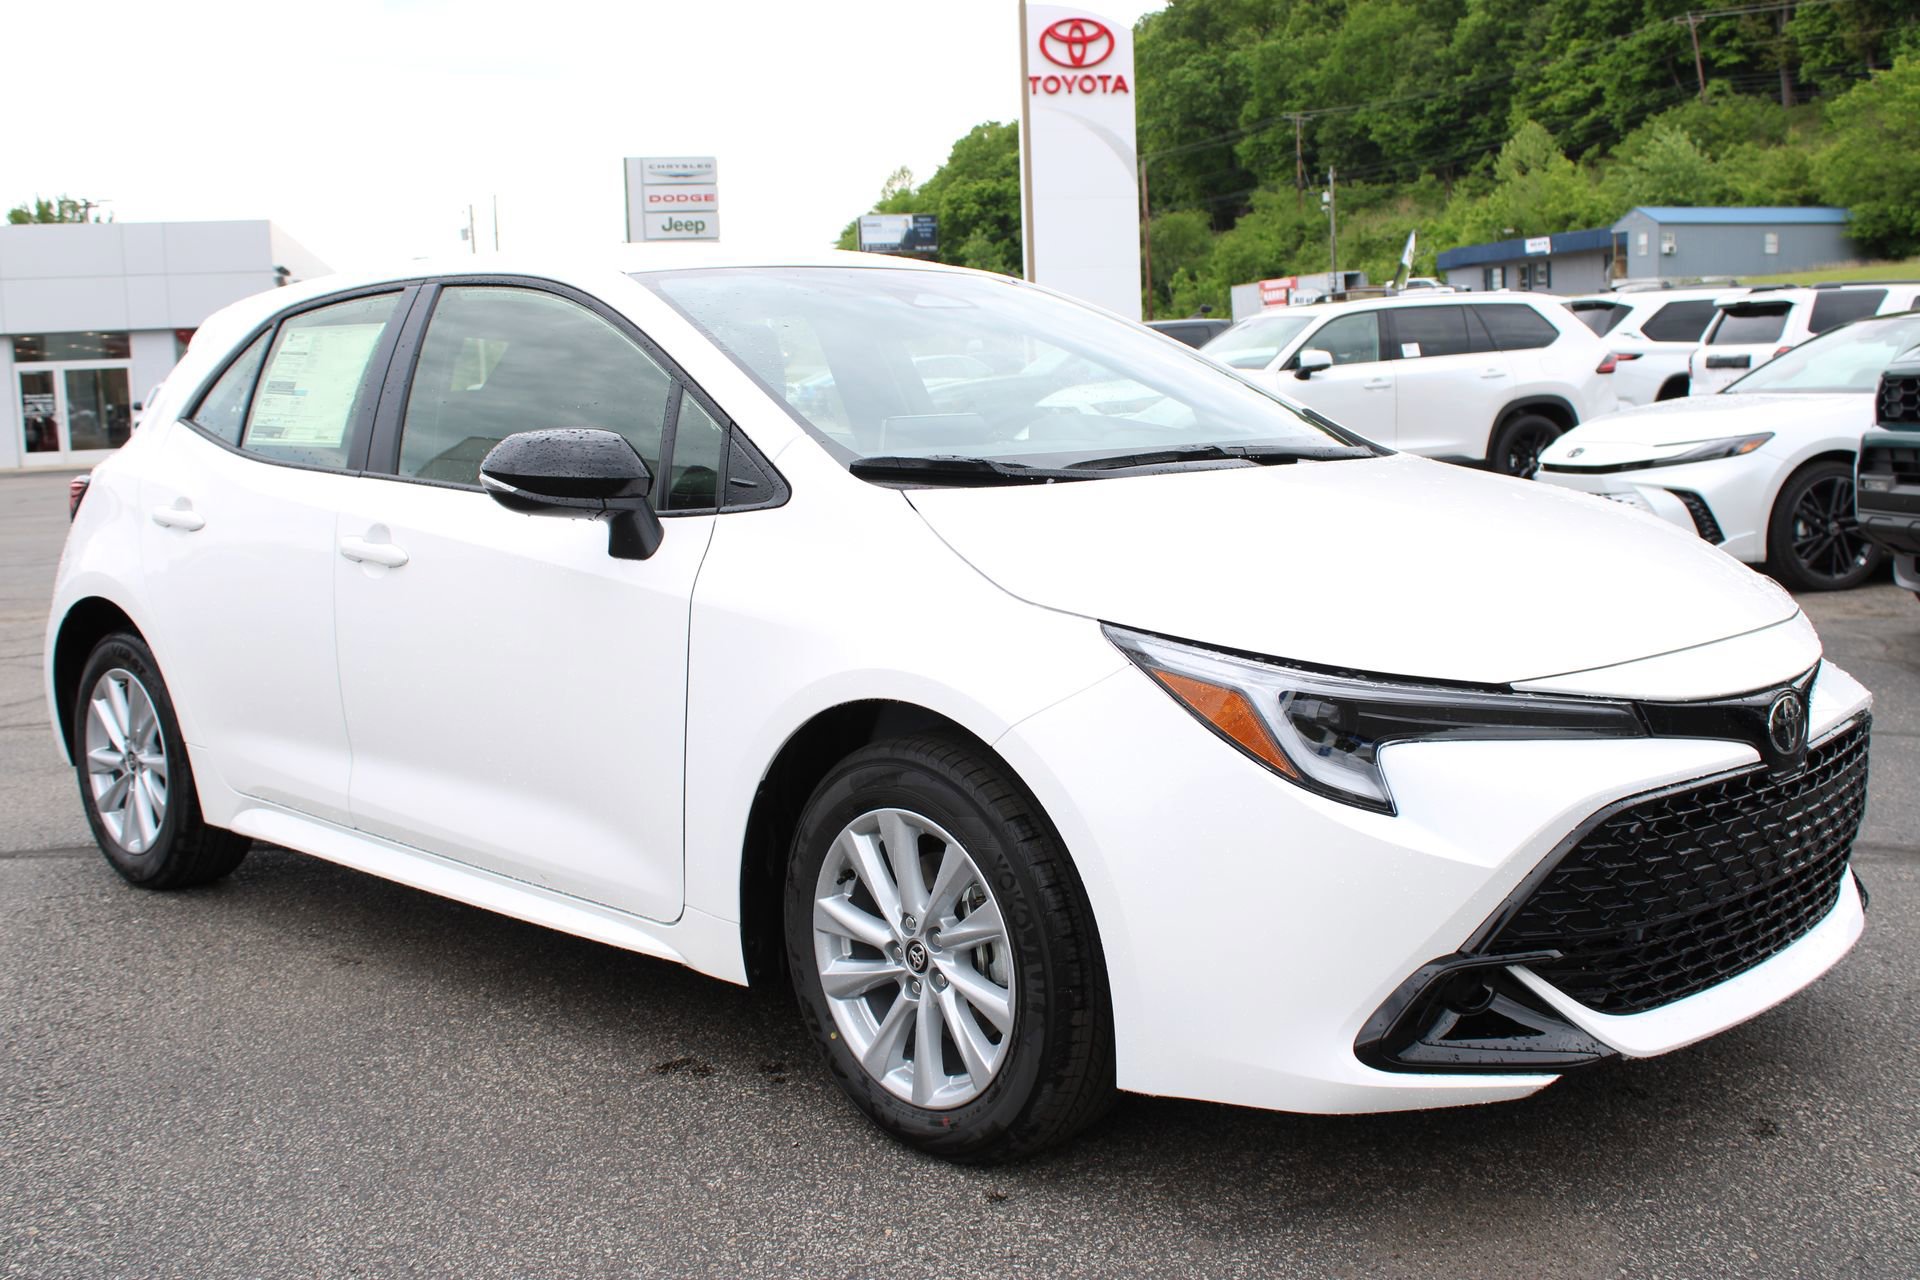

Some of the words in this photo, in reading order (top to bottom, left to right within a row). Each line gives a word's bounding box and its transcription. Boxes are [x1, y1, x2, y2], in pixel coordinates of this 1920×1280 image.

[1028, 75, 1129, 95] TOYOTA
[648, 194, 715, 203] DODGE
[661, 216, 706, 234] Jeep
